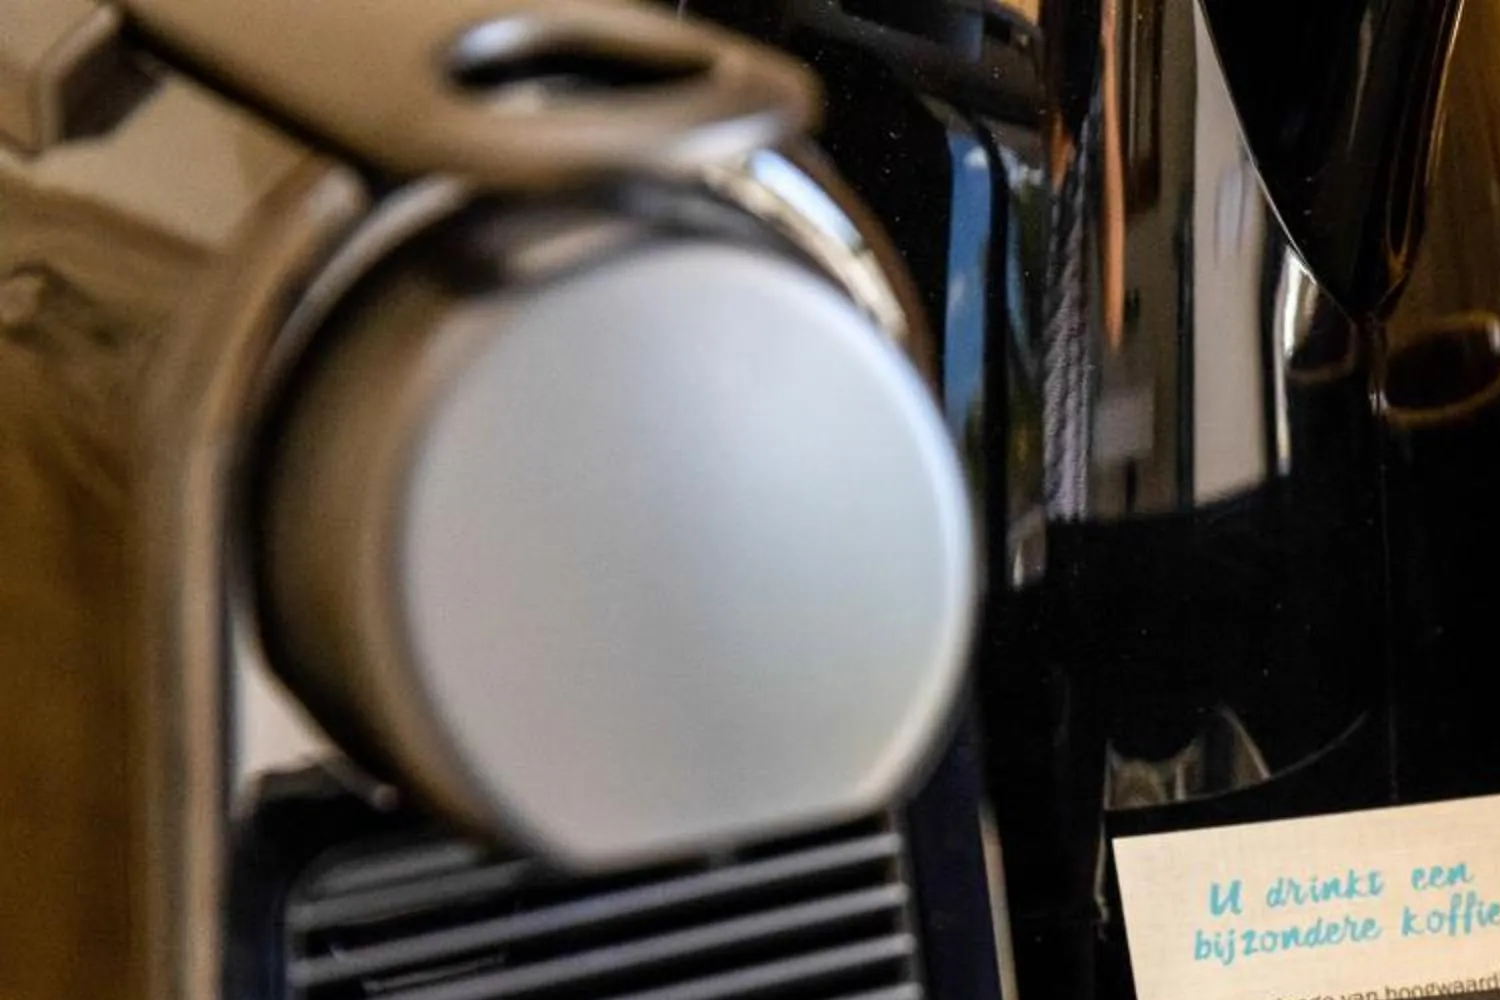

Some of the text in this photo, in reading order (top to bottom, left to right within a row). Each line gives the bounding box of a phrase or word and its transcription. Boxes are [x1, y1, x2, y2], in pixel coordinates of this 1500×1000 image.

[1209, 861, 1474, 917] U drinkt een
[1193, 915, 1383, 967] bijzondere
